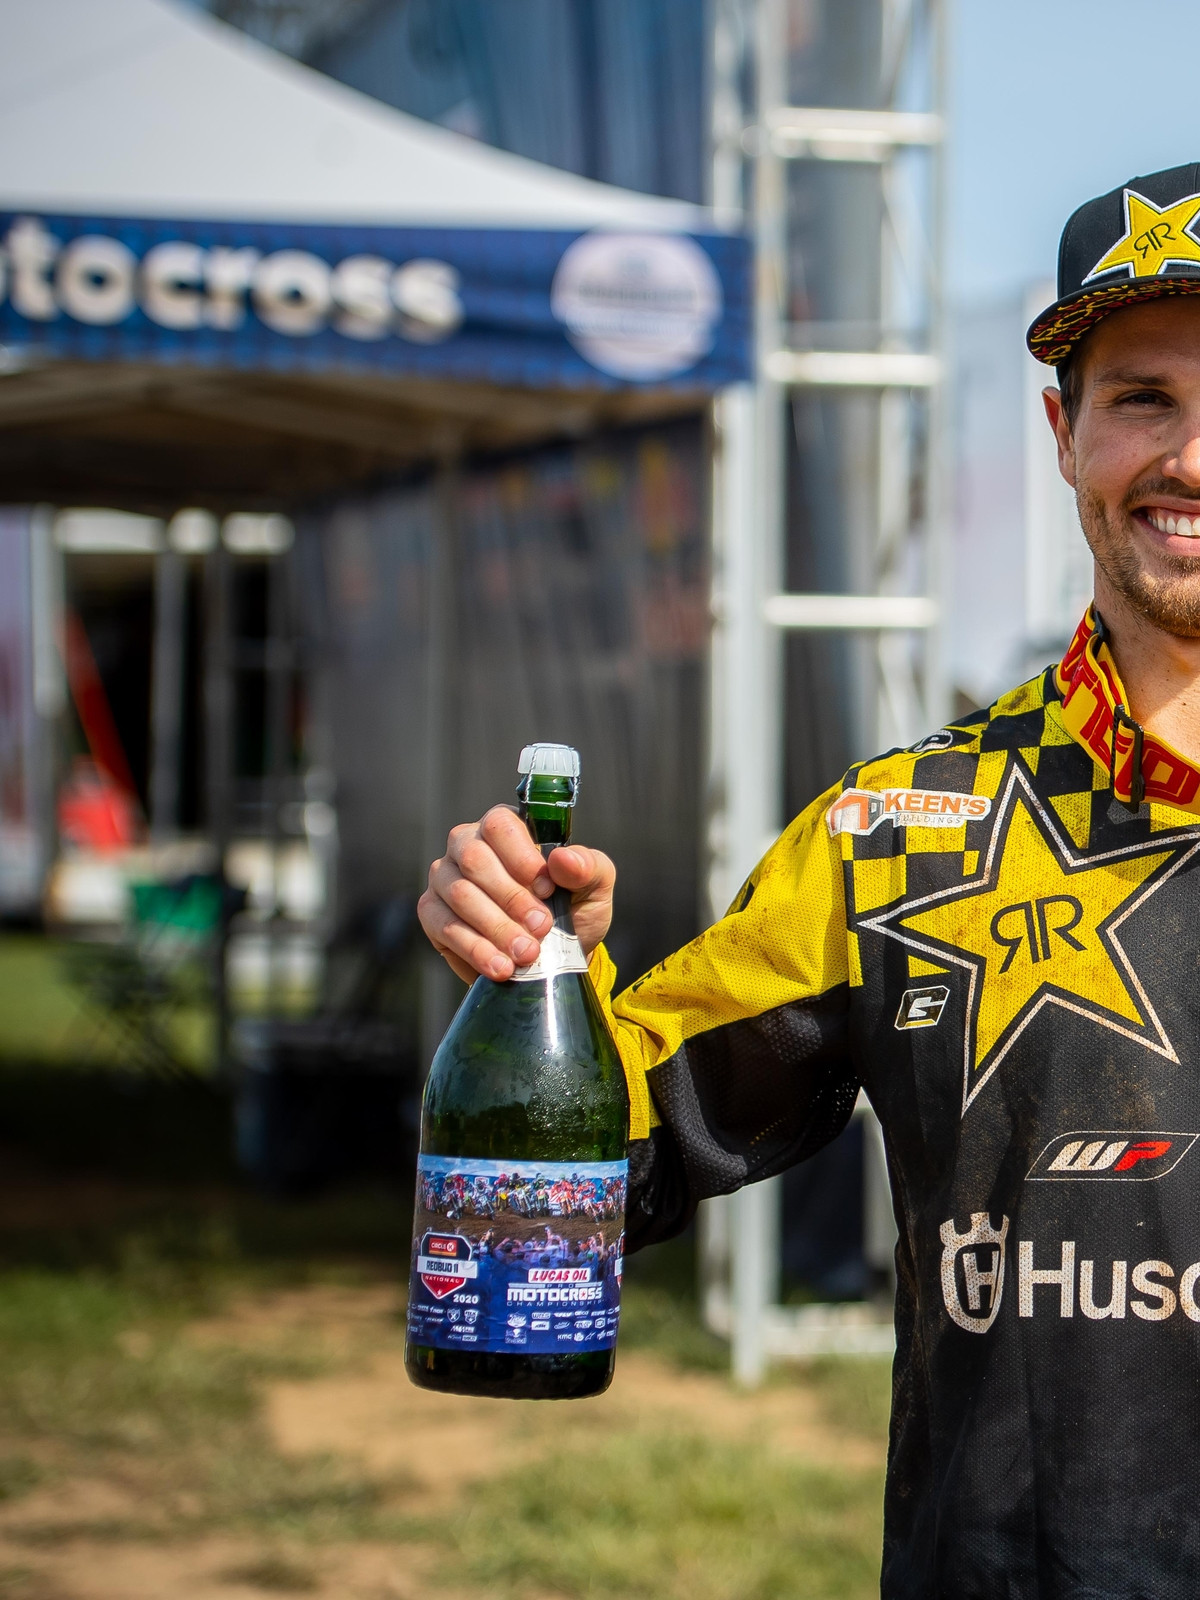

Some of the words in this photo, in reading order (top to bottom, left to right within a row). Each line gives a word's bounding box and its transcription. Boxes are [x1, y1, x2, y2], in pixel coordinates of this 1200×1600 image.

[0, 214, 464, 343] tocross
[884, 792, 987, 815] KEEN'S
[424, 1275, 461, 1284] NATIONAL
[532, 1270, 571, 1281] LUCAS
[572, 1269, 588, 1281] OIL
[453, 1294, 479, 1304] 2020
[507, 1287, 603, 1302] MOTOCROSS
[506, 1299, 603, 1307] CHAMPIONSHIP
